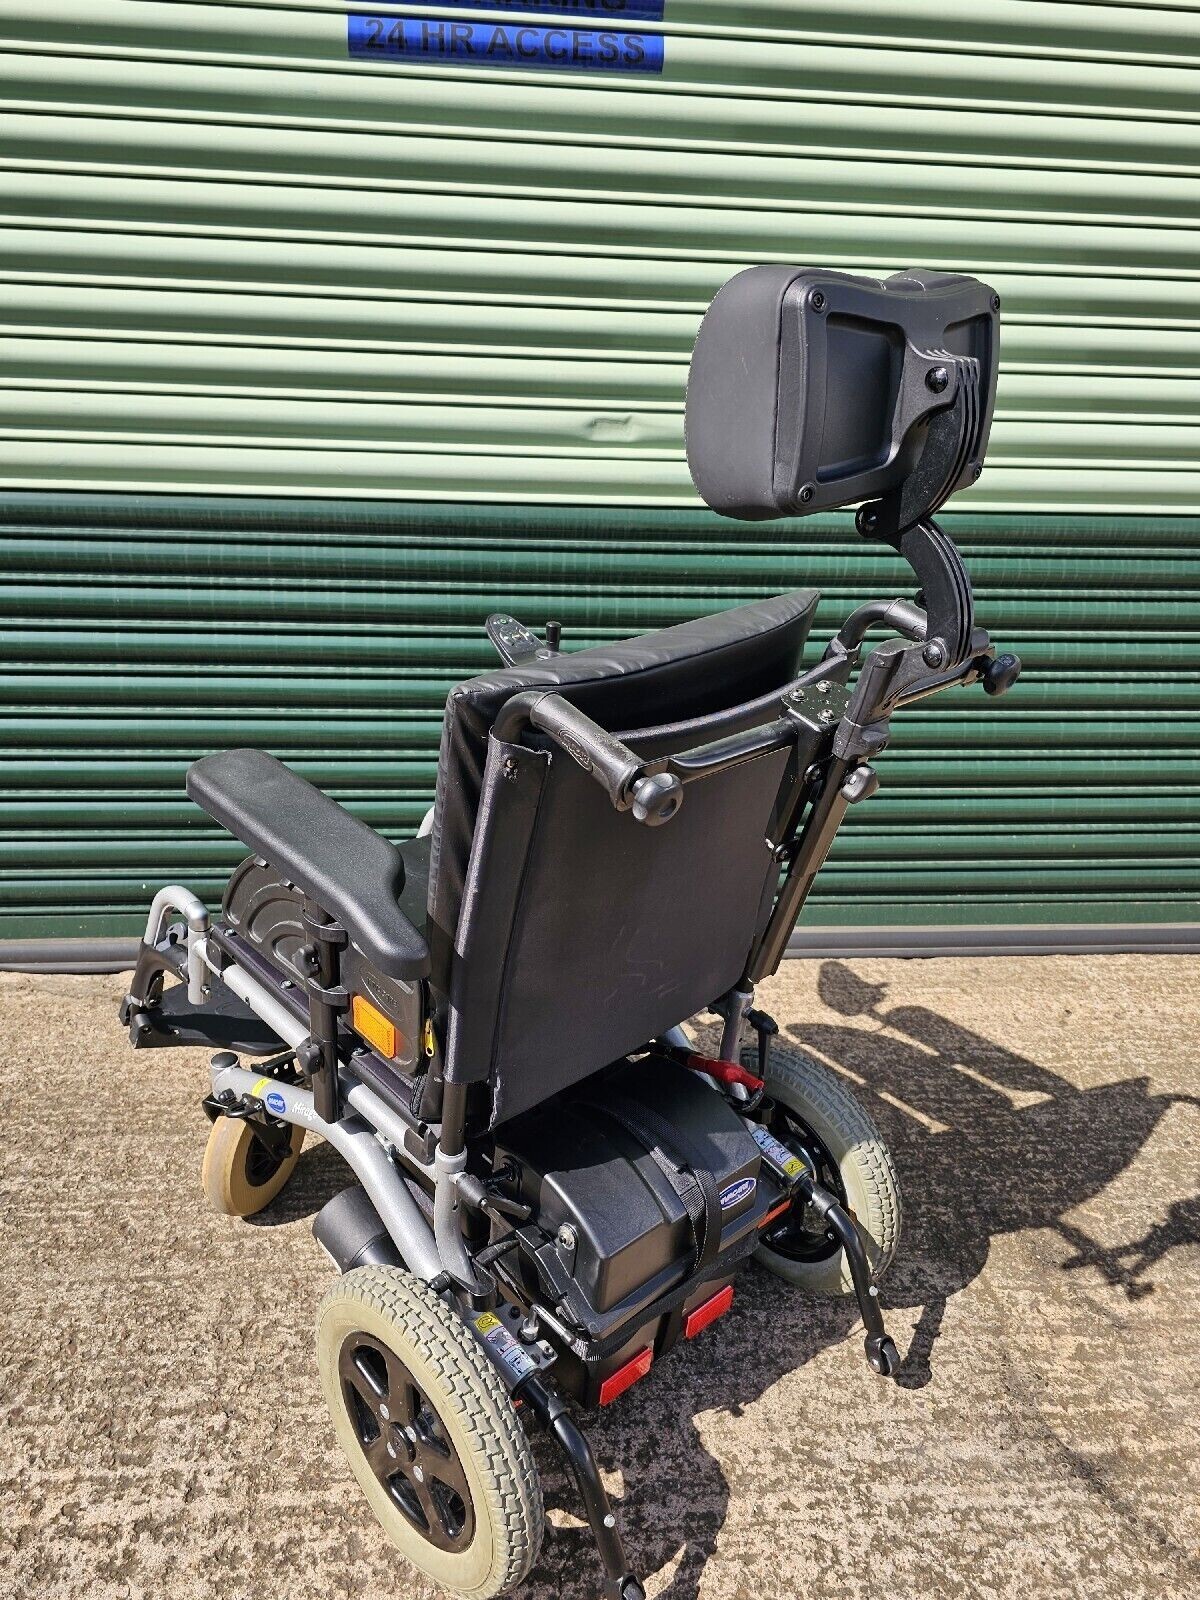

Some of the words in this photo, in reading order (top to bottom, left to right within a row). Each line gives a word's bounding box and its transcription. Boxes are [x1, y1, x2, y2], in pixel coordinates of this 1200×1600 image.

[365, 19, 407, 49] 24
[421, 22, 476, 54] HR
[486, 26, 645, 63] ACCESS
